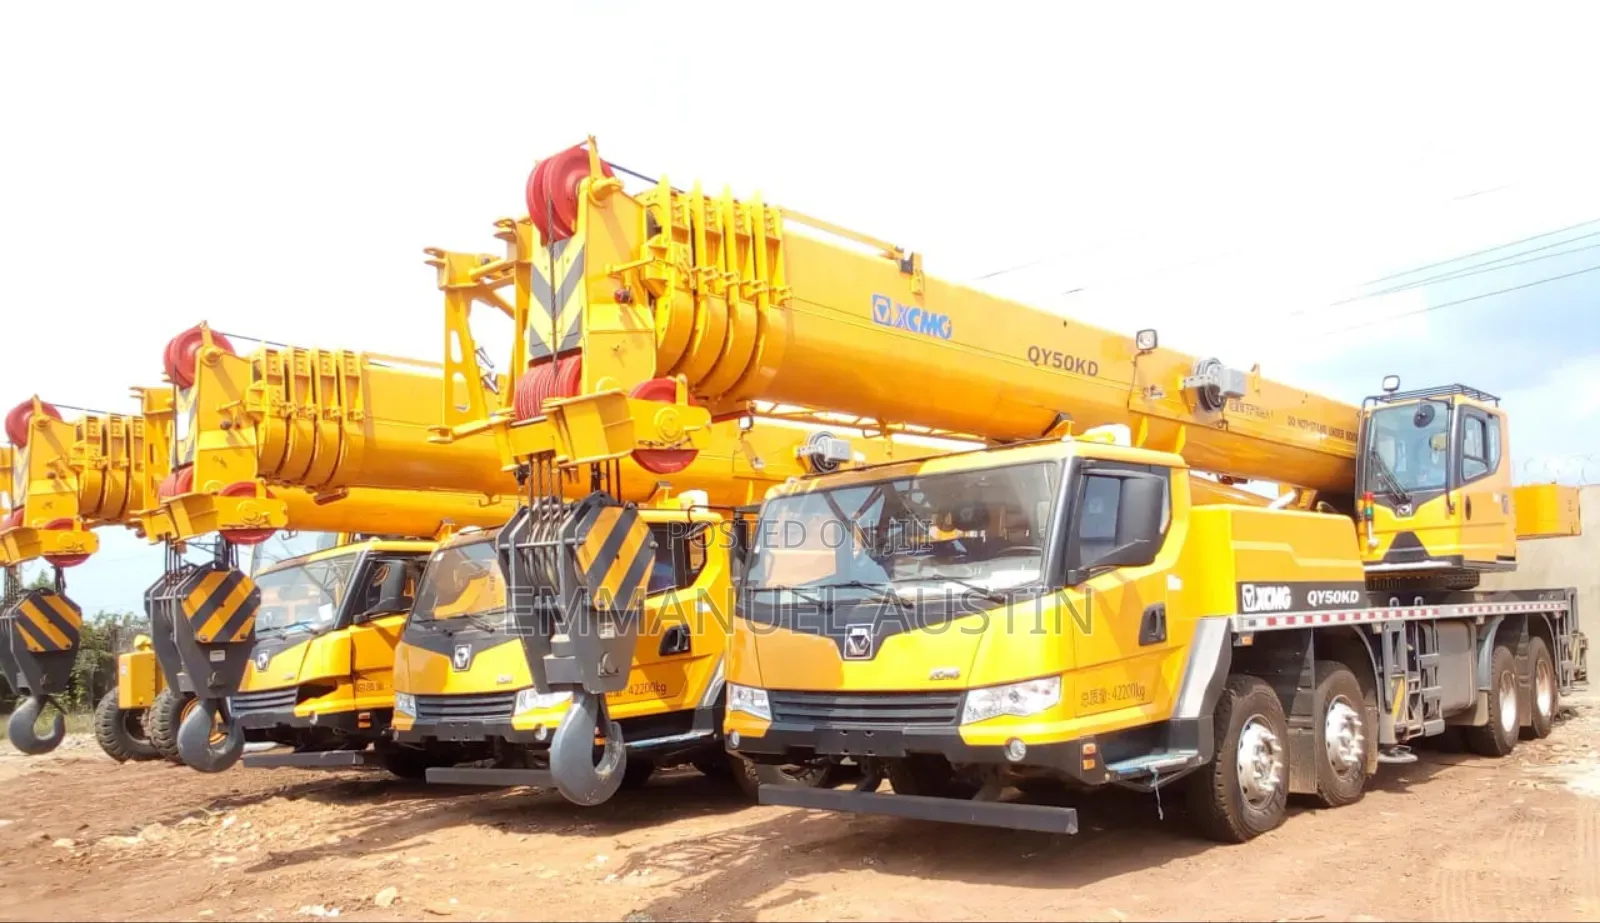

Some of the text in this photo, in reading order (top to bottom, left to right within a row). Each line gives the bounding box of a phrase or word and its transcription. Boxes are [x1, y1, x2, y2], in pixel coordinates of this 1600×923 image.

[895, 303, 952, 340] XCMG
[1027, 345, 1099, 377] QY50KD
[1256, 585, 1292, 610] XCMG
[1307, 590, 1360, 606] QY50KD
